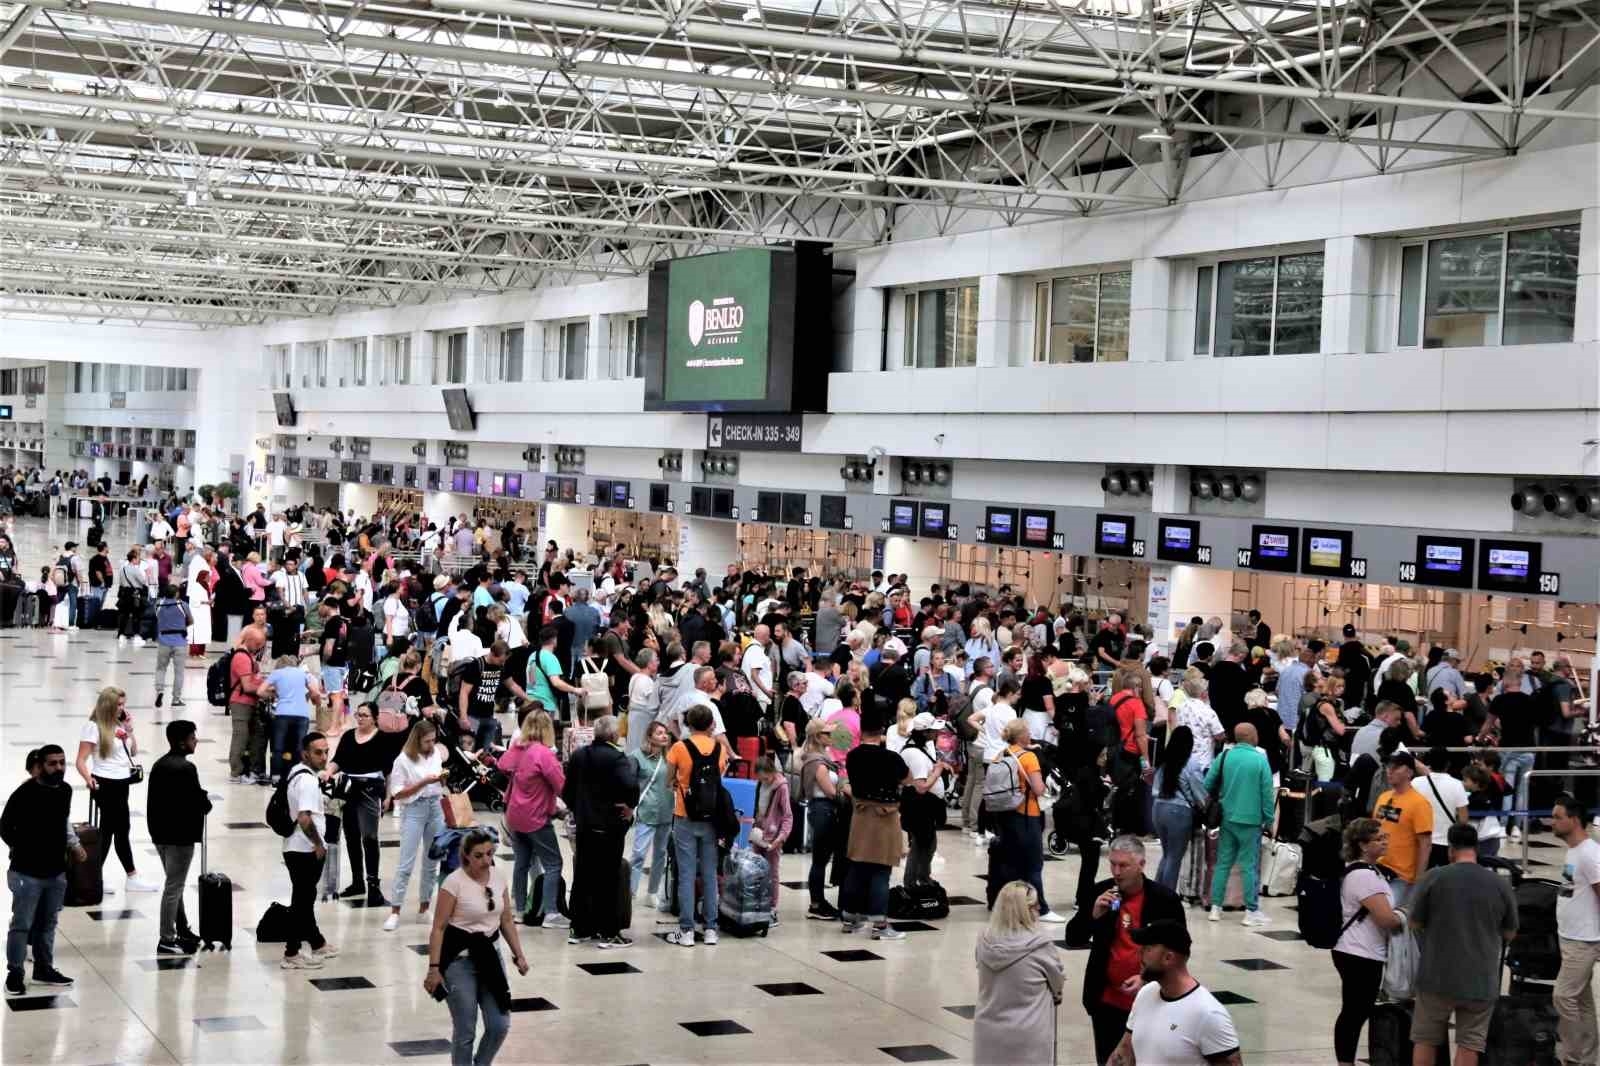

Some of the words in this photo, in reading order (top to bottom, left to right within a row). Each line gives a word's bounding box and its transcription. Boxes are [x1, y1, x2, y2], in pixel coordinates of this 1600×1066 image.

[764, 426, 779, 441] 335
[785, 426, 800, 442] 349
[948, 526, 957, 539] 142
[1053, 534, 1064, 548] 144
[1132, 541, 1144, 556] 145
[1198, 547, 1210, 562] 146
[1238, 551, 1251, 566] 147
[1350, 560, 1366, 577] 148
[1400, 564, 1416, 581] 149
[1539, 574, 1558, 593] 150
